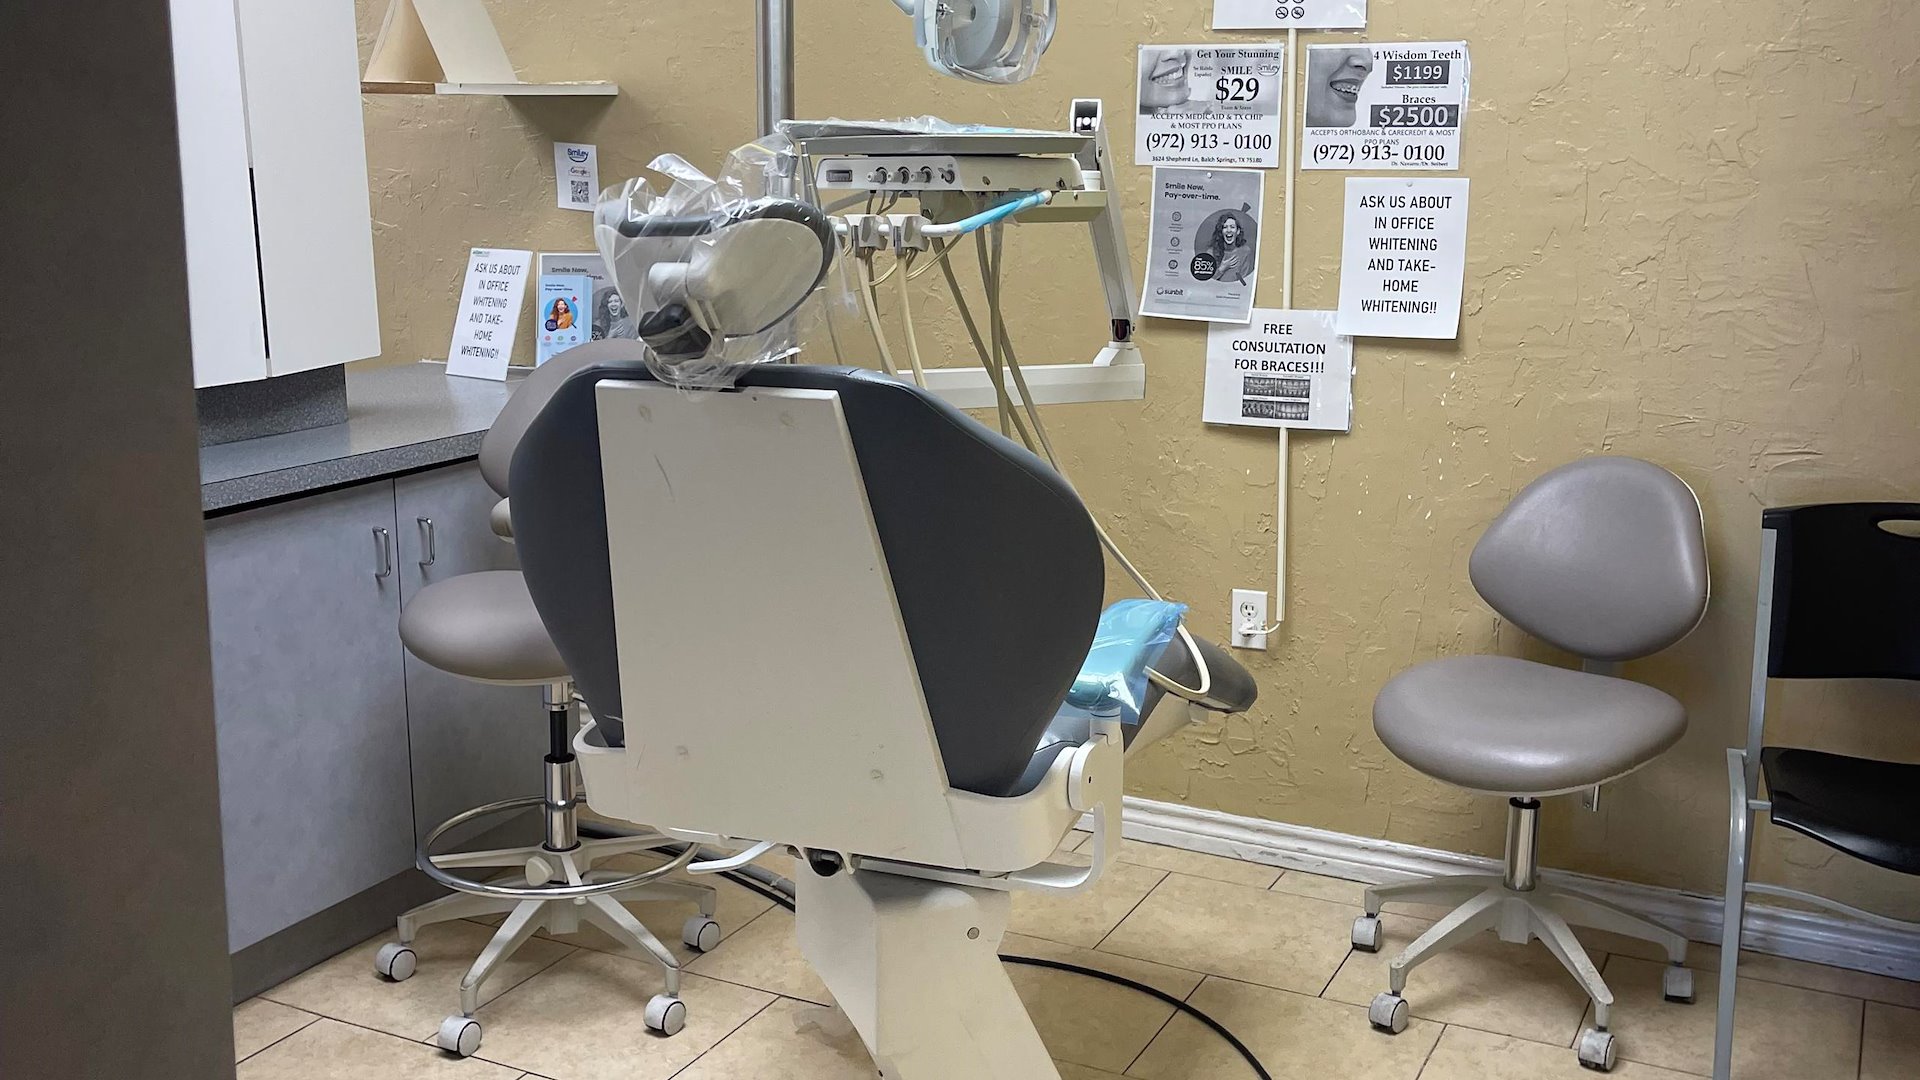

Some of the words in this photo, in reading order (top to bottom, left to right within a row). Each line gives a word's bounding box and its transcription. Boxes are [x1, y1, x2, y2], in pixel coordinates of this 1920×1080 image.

[1197, 50, 1211, 58] Get
[1215, 50, 1235, 58] Your
[1238, 49, 1279, 60] Stunning
[1373, 51, 1380, 60] 4
[1383, 51, 1427, 60] Wisdom
[1430, 50, 1462, 60] Teeth
[1220, 65, 1253, 75] SMILE
[1393, 64, 1443, 82] $1199
[1215, 76, 1260, 104] $29
[1402, 94, 1436, 104] Braces
[1378, 106, 1448, 129] $2500
[1388, 129, 1427, 137] CARECREDIT
[1436, 129, 1456, 137] MOST
[1146, 133, 1185, 152] (972)
[1190, 133, 1219, 149] 913
[1234, 134, 1272, 150] 0100
[568, 148, 589, 158] Smiley
[1313, 144, 1355, 164] (972)
[1404, 145, 1445, 161] 0100
[1165, 182, 1185, 190] Smile
[1187, 183, 1205, 191] Now,
[1164, 192, 1221, 201] Pay-over-time.
[1359, 195, 1386, 208] ASK
[1389, 195, 1406, 208] US
[1409, 196, 1453, 209] ABOUT
[1374, 216, 1387, 229] IN
[1391, 216, 1435, 230] OFFICE
[1368, 237, 1438, 251] WHITENING
[474, 262, 489, 272] ASK
[489, 263, 498, 274] US
[498, 264, 521, 276] ABOUT
[1194, 260, 1214, 271] 85%
[1367, 258, 1394, 271] AND
[1398, 259, 1436, 272] TAKE-
[479, 279, 486, 290] IN
[486, 280, 510, 292] OFFICE
[1164, 288, 1184, 296] sunbit
[1382, 279, 1419, 292] HOME
[473, 296, 508, 309] WHITENING
[1361, 299, 1437, 314] WHITENING!!
[469, 312, 483, 324] AND
[484, 313, 504, 326] TAKE-
[474, 329, 493, 341] HOME
[1263, 323, 1294, 335] FREE
[461, 345, 500, 360] WHITENING!!
[1232, 340, 1326, 355] CONSULTATION
[1234, 358, 1258, 371] FOR
[1261, 360, 1325, 374] BRACES!!!
